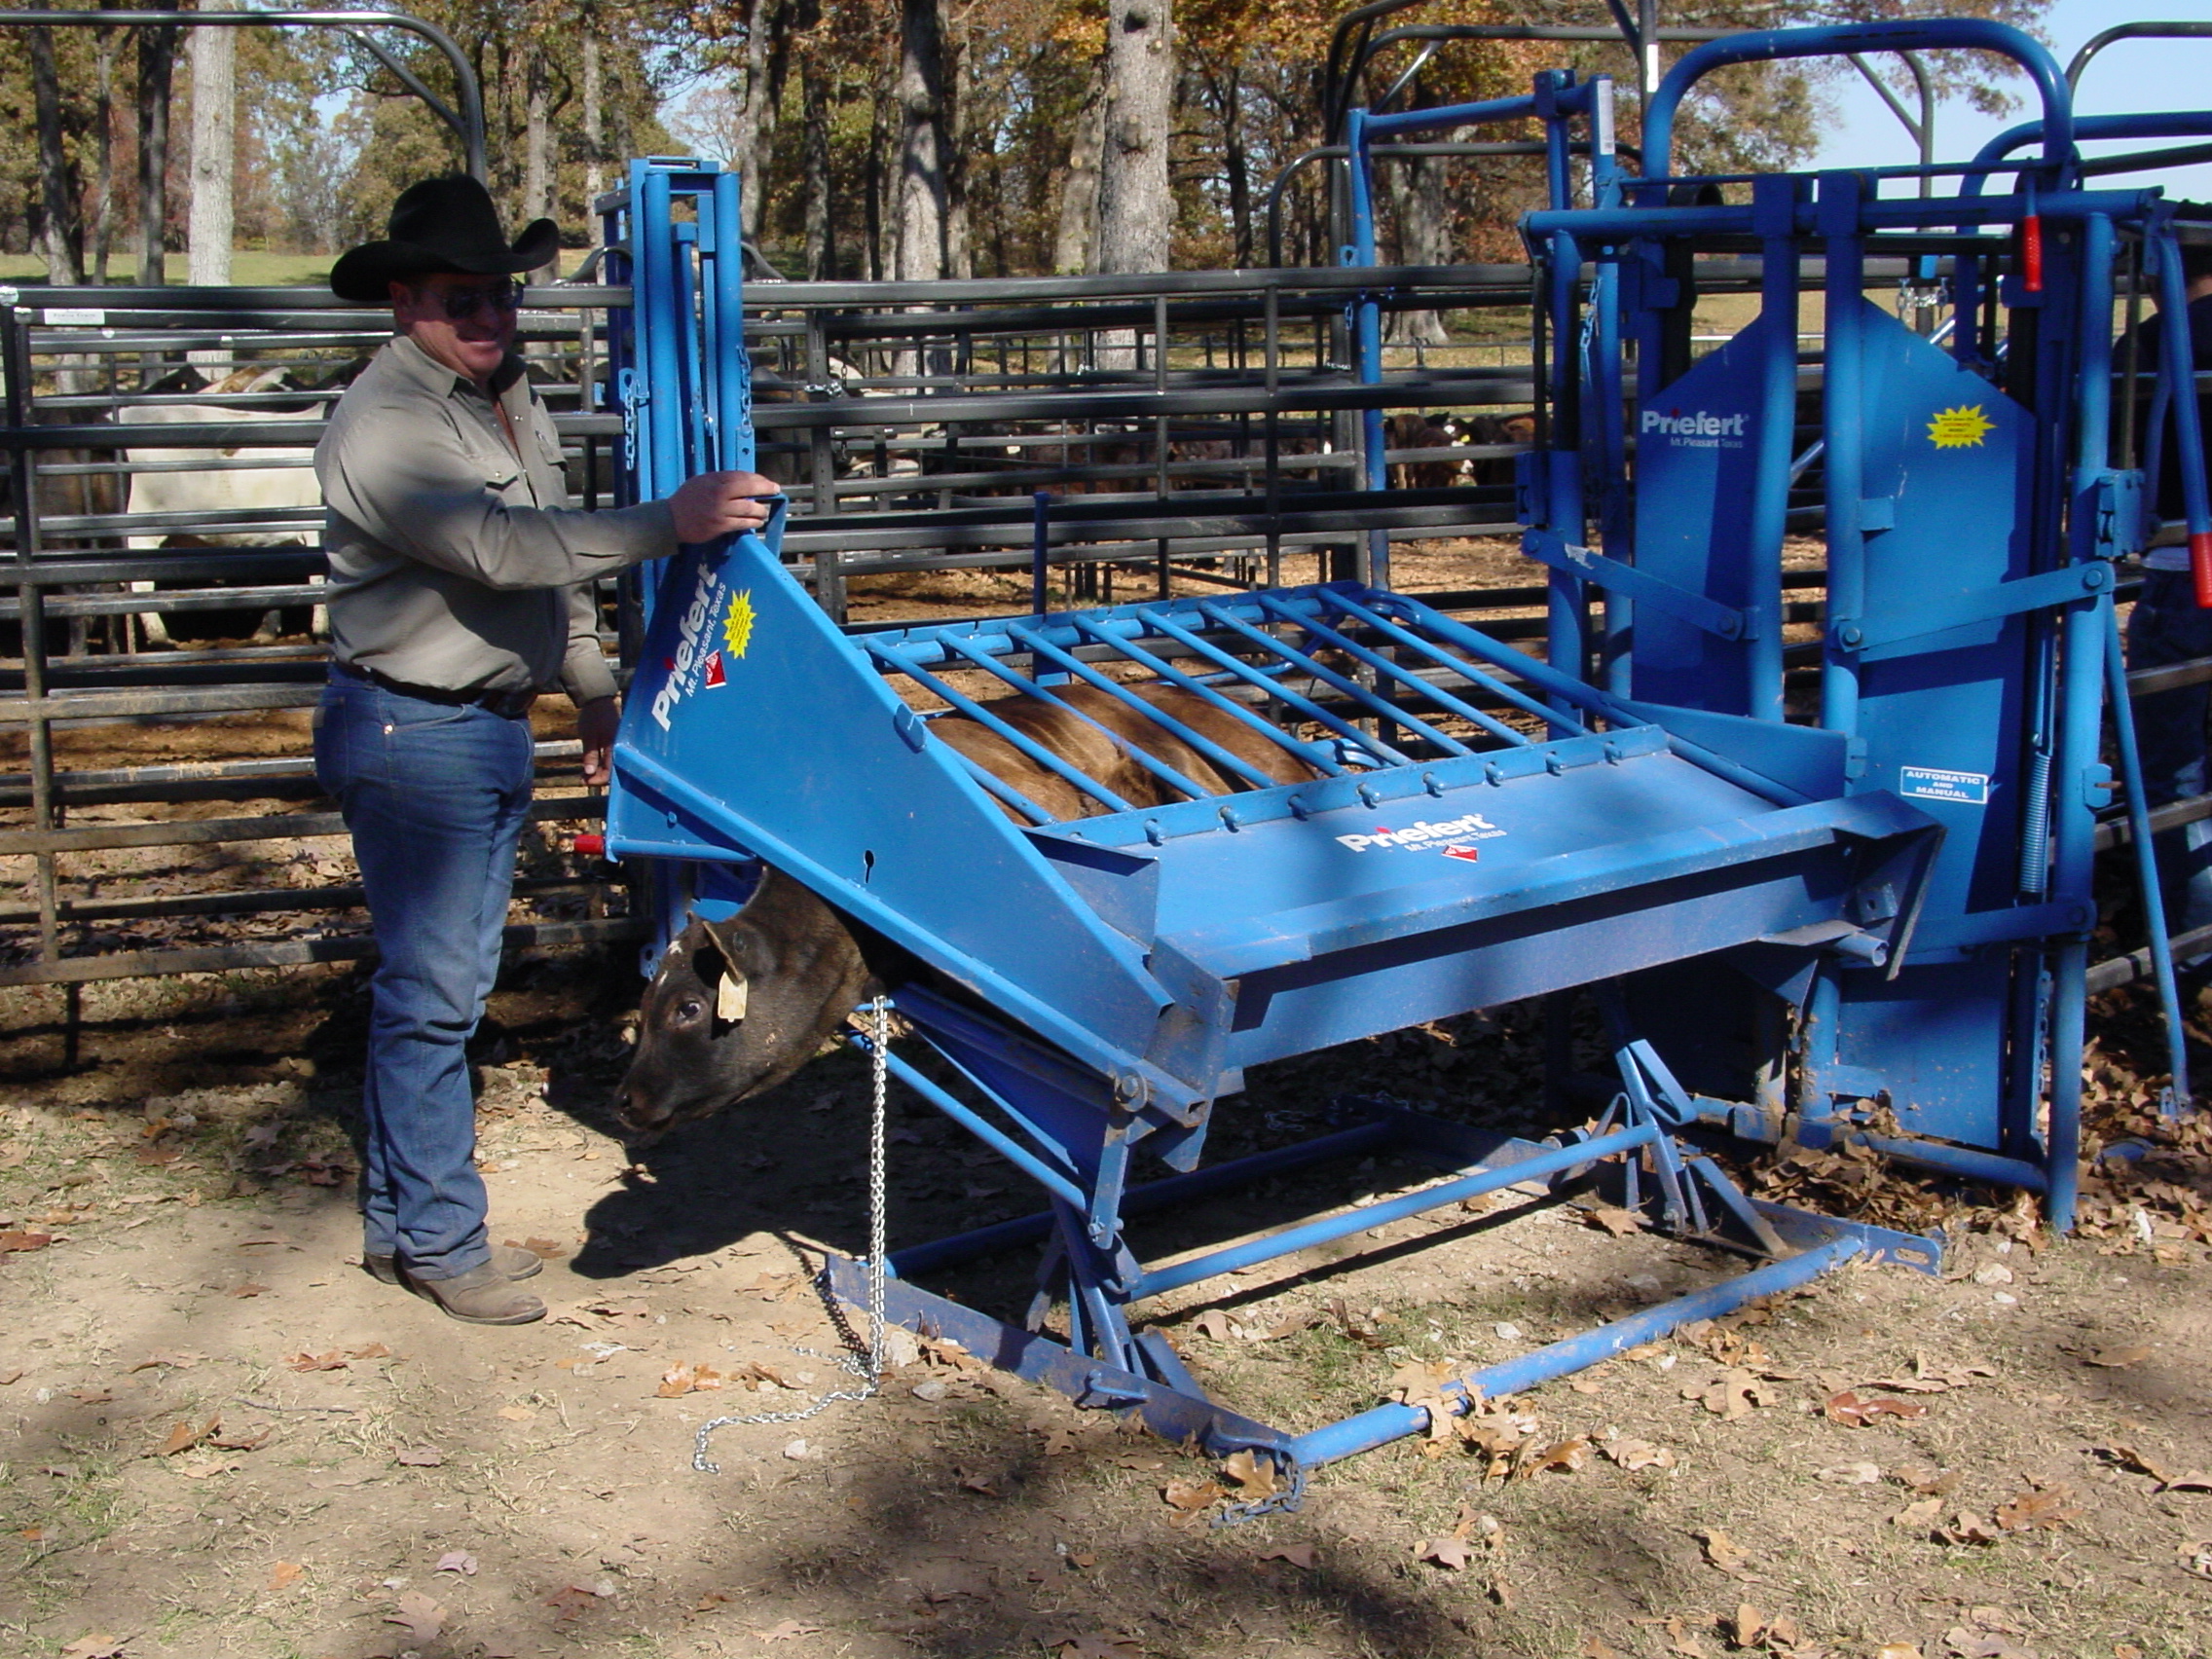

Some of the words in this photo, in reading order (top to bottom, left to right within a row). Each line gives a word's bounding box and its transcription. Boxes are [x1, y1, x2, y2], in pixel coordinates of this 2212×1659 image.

[1641, 407, 1744, 436] Priefert
[651, 563, 718, 732] Priefert
[684, 678, 698, 697] Mt.
[709, 582, 726, 617] Texas
[1905, 770, 1980, 785] AUTOMATIC
[1916, 787, 1970, 798] MANUAL
[1335, 813, 1496, 853] Priefert
[1476, 830, 1508, 840] Texas
